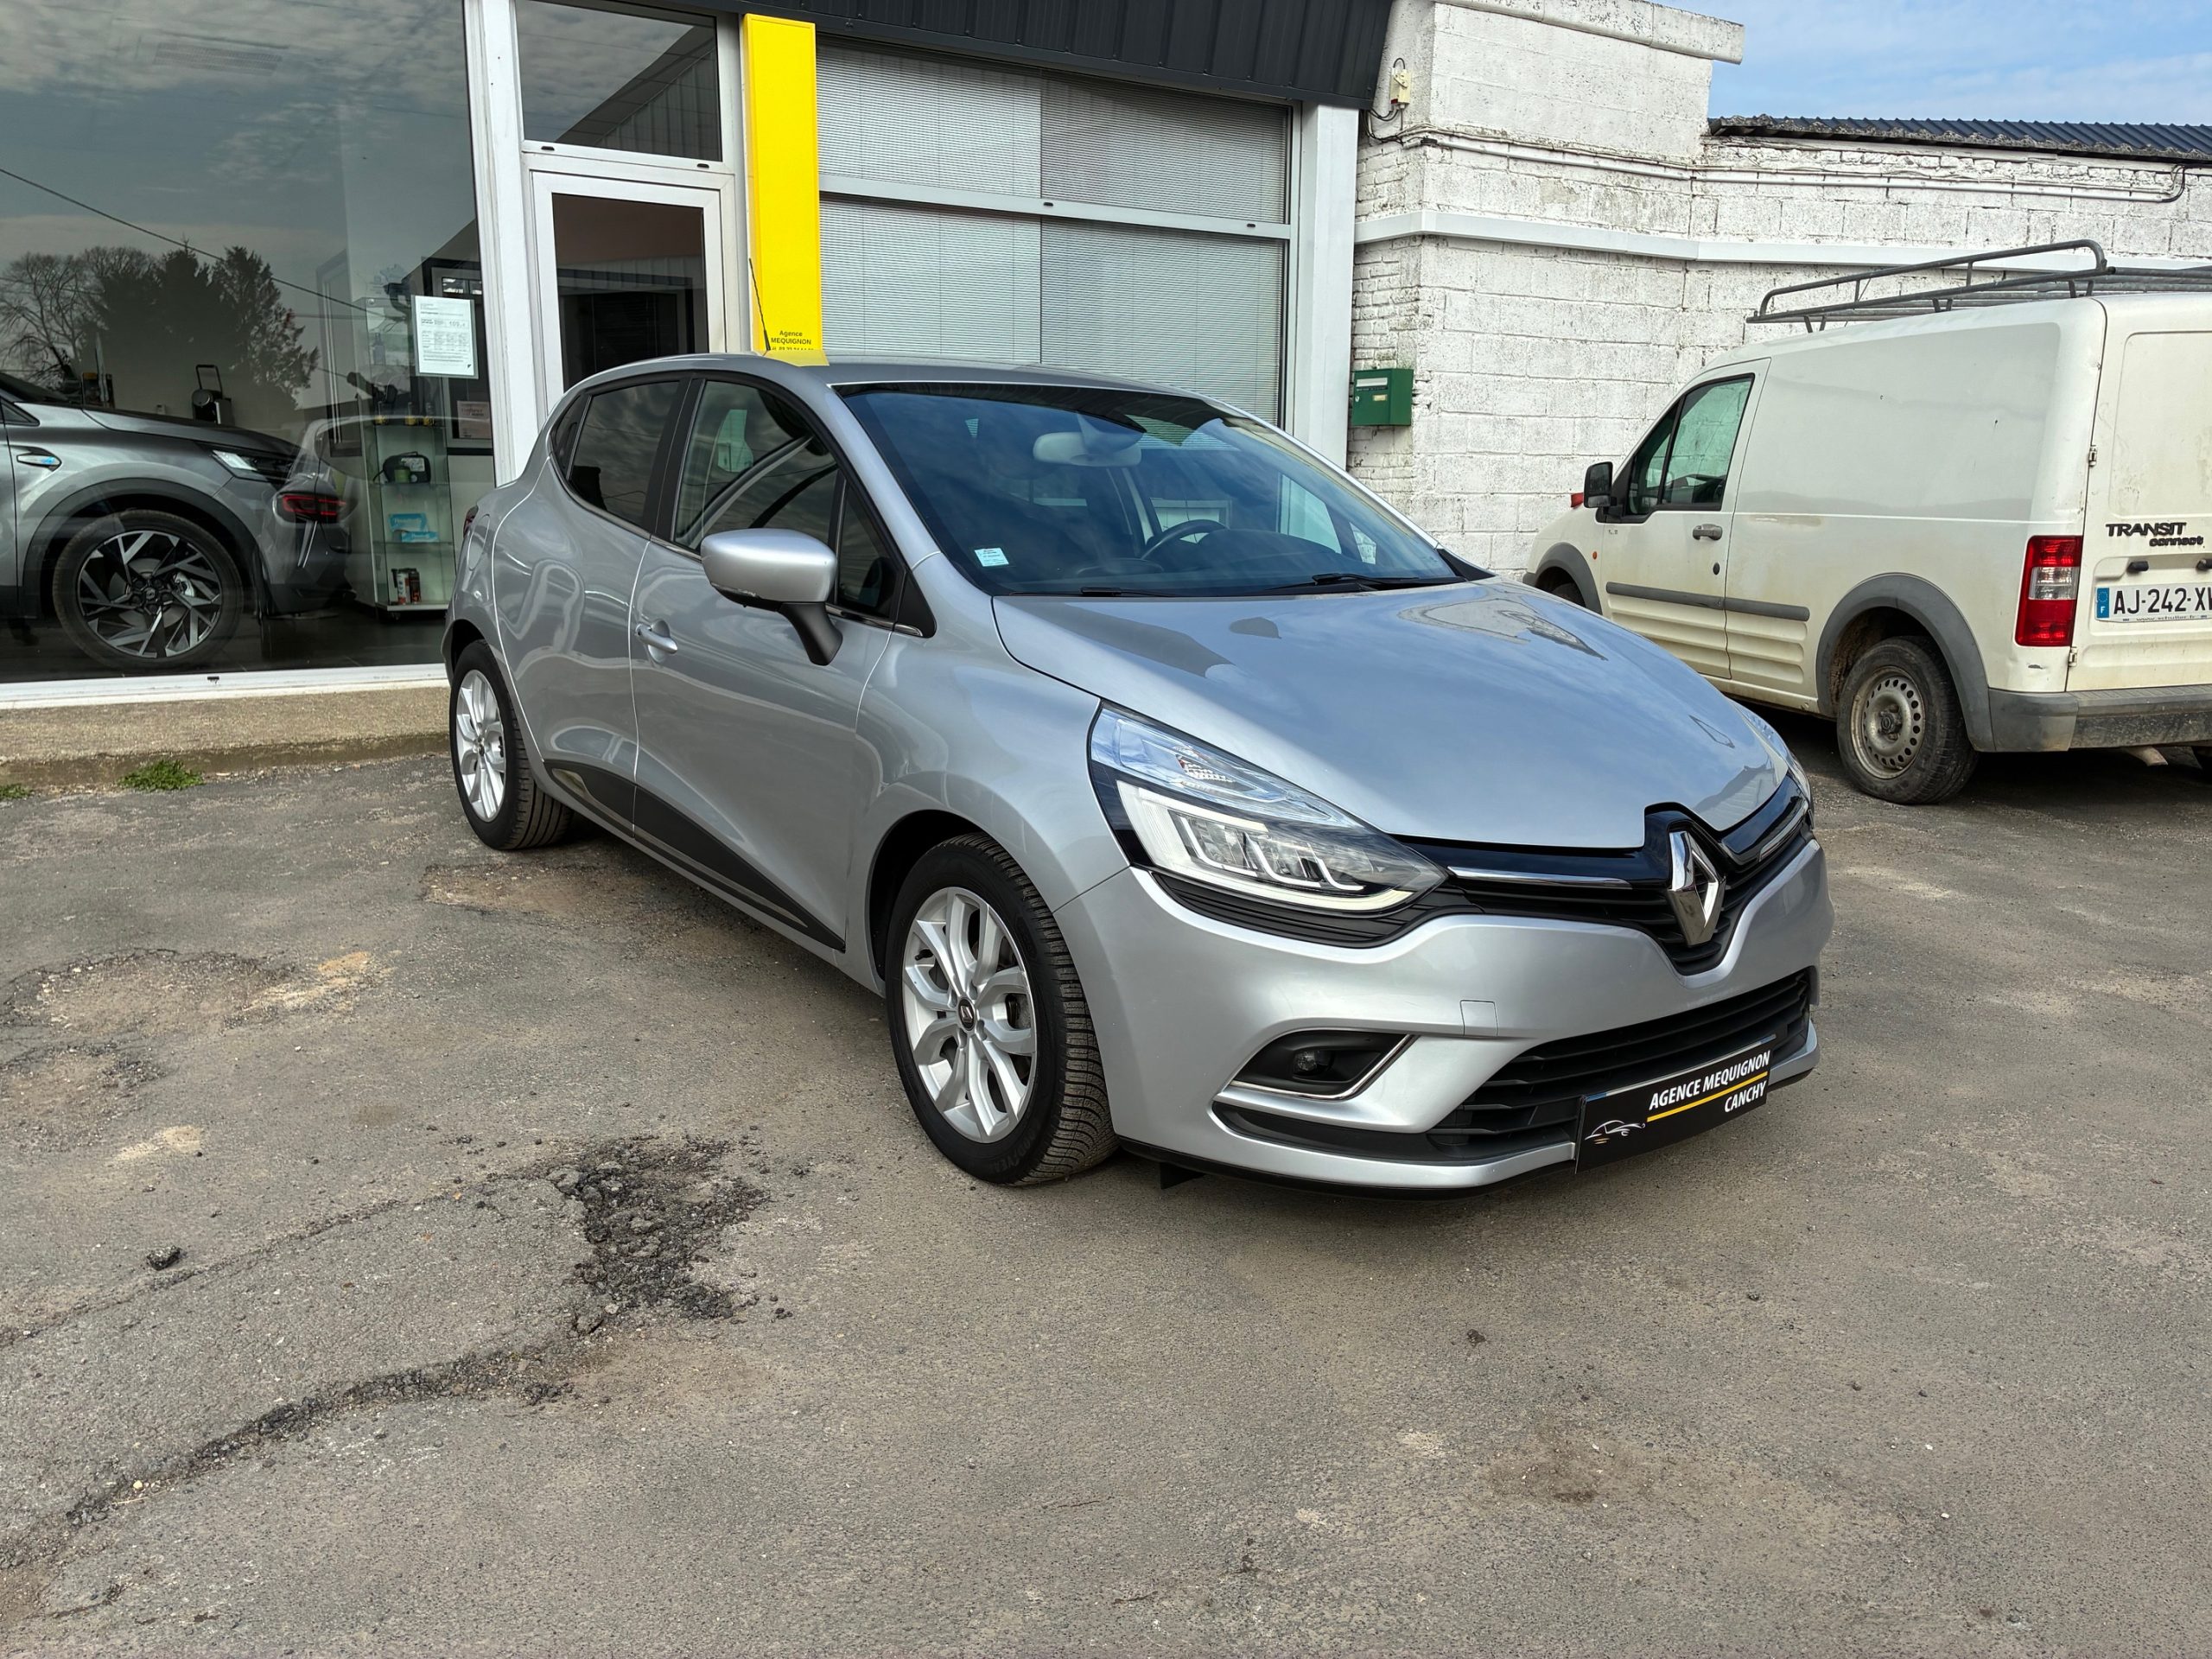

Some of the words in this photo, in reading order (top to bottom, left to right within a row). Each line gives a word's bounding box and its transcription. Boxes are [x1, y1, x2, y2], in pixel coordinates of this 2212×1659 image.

[2105, 522, 2187, 537] TRANSIT
[2149, 536, 2204, 547] connect
[1649, 1078, 1701, 1110] AGENCE
[1702, 1050, 1770, 1092] MEQUIGNON
[1724, 1080, 1767, 1113] CANCHY
